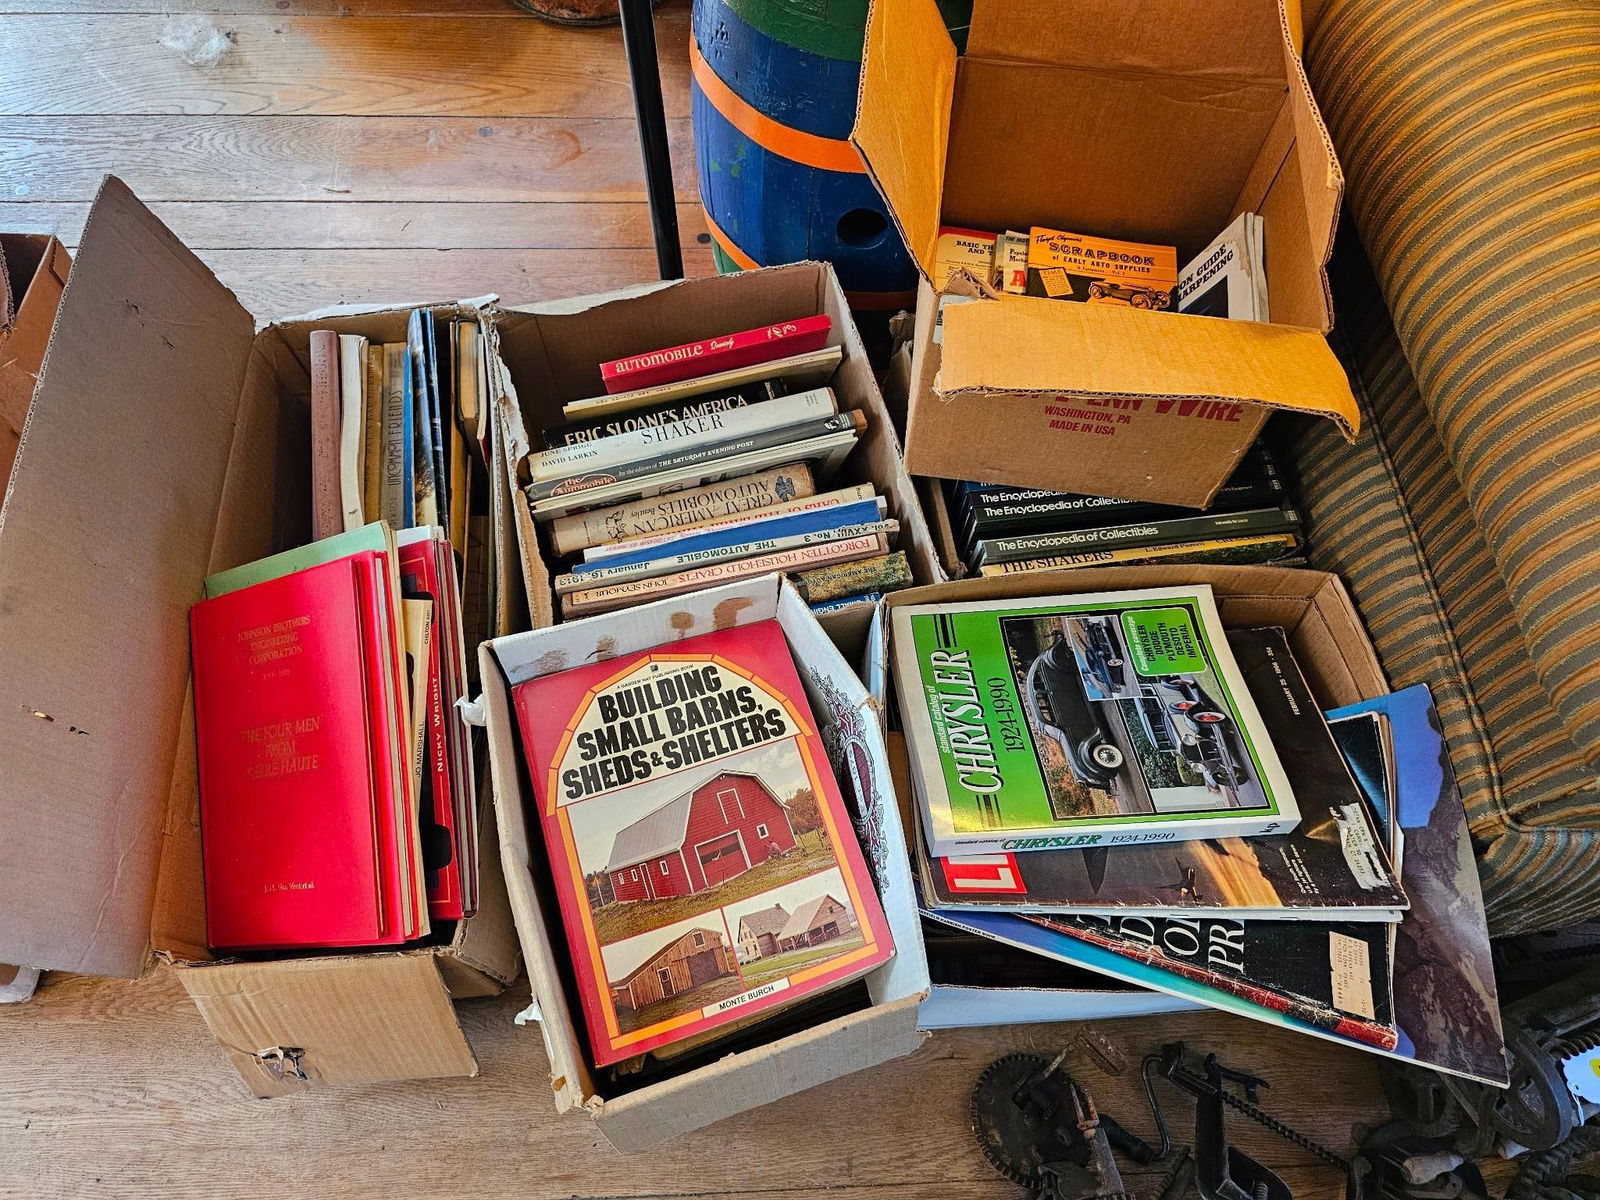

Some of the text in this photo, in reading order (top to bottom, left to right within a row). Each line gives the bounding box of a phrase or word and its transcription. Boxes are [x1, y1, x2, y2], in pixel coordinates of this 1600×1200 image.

[956, 240, 979, 249] BASIC
[1049, 242, 1156, 266] SCRAPBOOK
[1063, 257, 1086, 265] EARLY
[1090, 261, 1110, 269] AUTO
[1114, 263, 1151, 274] SUPPLIES
[1180, 243, 1227, 290] ON GUIDE
[388, 390, 403, 436] FRIENDS
[564, 395, 747, 446] ERIC SLOANE'S AMERICA
[1044, 405, 1132, 424] WASHINGTON, PA
[642, 413, 724, 445] SHAKER
[1049, 419, 1116, 435] MADE IN USA
[387, 437, 402, 487] UNCOMMON
[541, 450, 598, 467] DAVID LARKIN
[659, 459, 672, 467] THE
[672, 451, 706, 464] SATURDAY
[707, 445, 735, 456] EVENING
[736, 440, 754, 450] POST
[657, 479, 769, 514] AUTOMOBILES
[723, 493, 773, 516] GREAT
[980, 494, 999, 503] The
[984, 506, 1003, 517] The
[1004, 501, 1072, 514] Encyclopedia
[1072, 499, 1084, 508] of
[634, 507, 714, 535] AMERICAN
[676, 540, 776, 563] THE AUTOMOBILE
[997, 526, 1159, 551] The Encyclopedia of Collectibles
[596, 538, 870, 597] FORGOTTEN HOUSEHOLD CRAFTS JOHN SEYMOUR
[607, 562, 651, 574] January
[1001, 551, 1114, 573] THE SHAKERS
[559, 574, 584, 585] 1913
[273, 615, 311, 632] BROTHERS
[1137, 625, 1156, 662] CHRYSLER
[1149, 630, 1164, 655] DODGE
[1157, 622, 1176, 662] PLYMOUTH
[1169, 627, 1185, 656] DESOTO
[1179, 623, 1197, 658] IMPERIAL
[249, 645, 302, 665] CORPORATION
[597, 665, 722, 724] BUILDING
[930, 694, 943, 721] catalog
[1283, 687, 1300, 716] FEBRUARY
[295, 717, 320, 734] MEN
[577, 686, 763, 761] SMALL BARNS,
[930, 650, 1004, 793] CHRYSLER
[987, 677, 1026, 752] 1924-1990
[416, 722, 425, 778] JO MARSHALL
[934, 720, 950, 754] standard
[281, 755, 319, 775] HAUTE
[562, 707, 787, 799] SHEDS & SHELTERS
[1001, 832, 1175, 850] CHRYSLER 1924-1990
[719, 985, 774, 1010] MONTE BURCH
